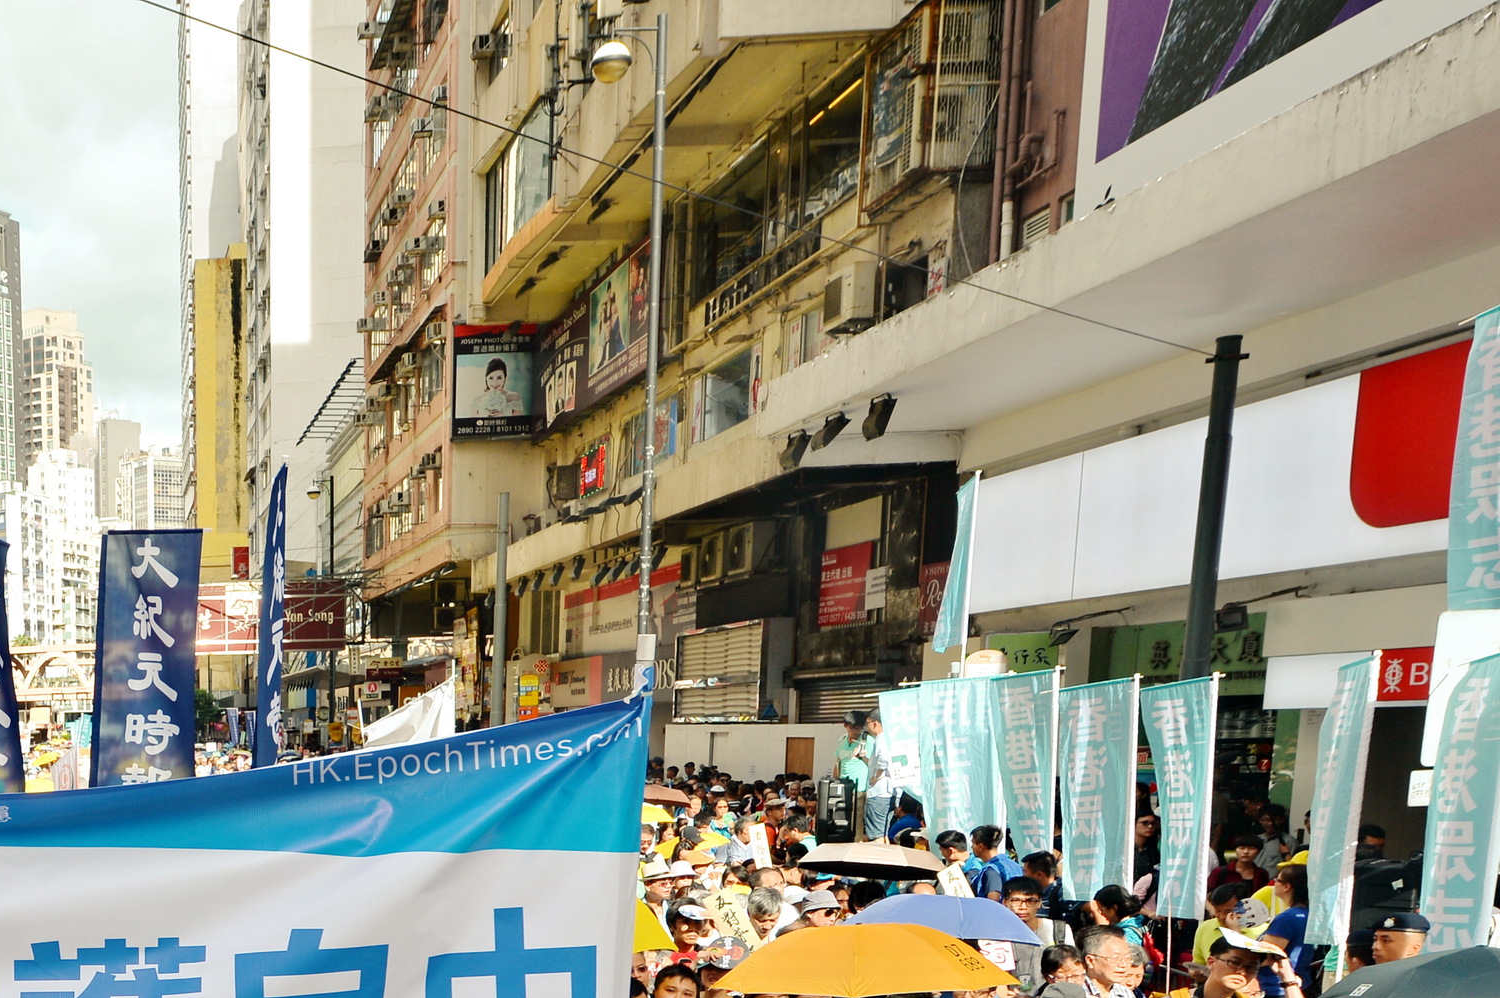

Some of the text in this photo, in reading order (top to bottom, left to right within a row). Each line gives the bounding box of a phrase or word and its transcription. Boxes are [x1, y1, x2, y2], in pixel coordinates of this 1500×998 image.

[457, 427, 474, 435] 2890
[476, 426, 491, 434] 2228
[285, 609, 334, 624] Yan Sang
[1151, 631, 1264, 669] 英大廈
[607, 666, 635, 693] 星展銀
